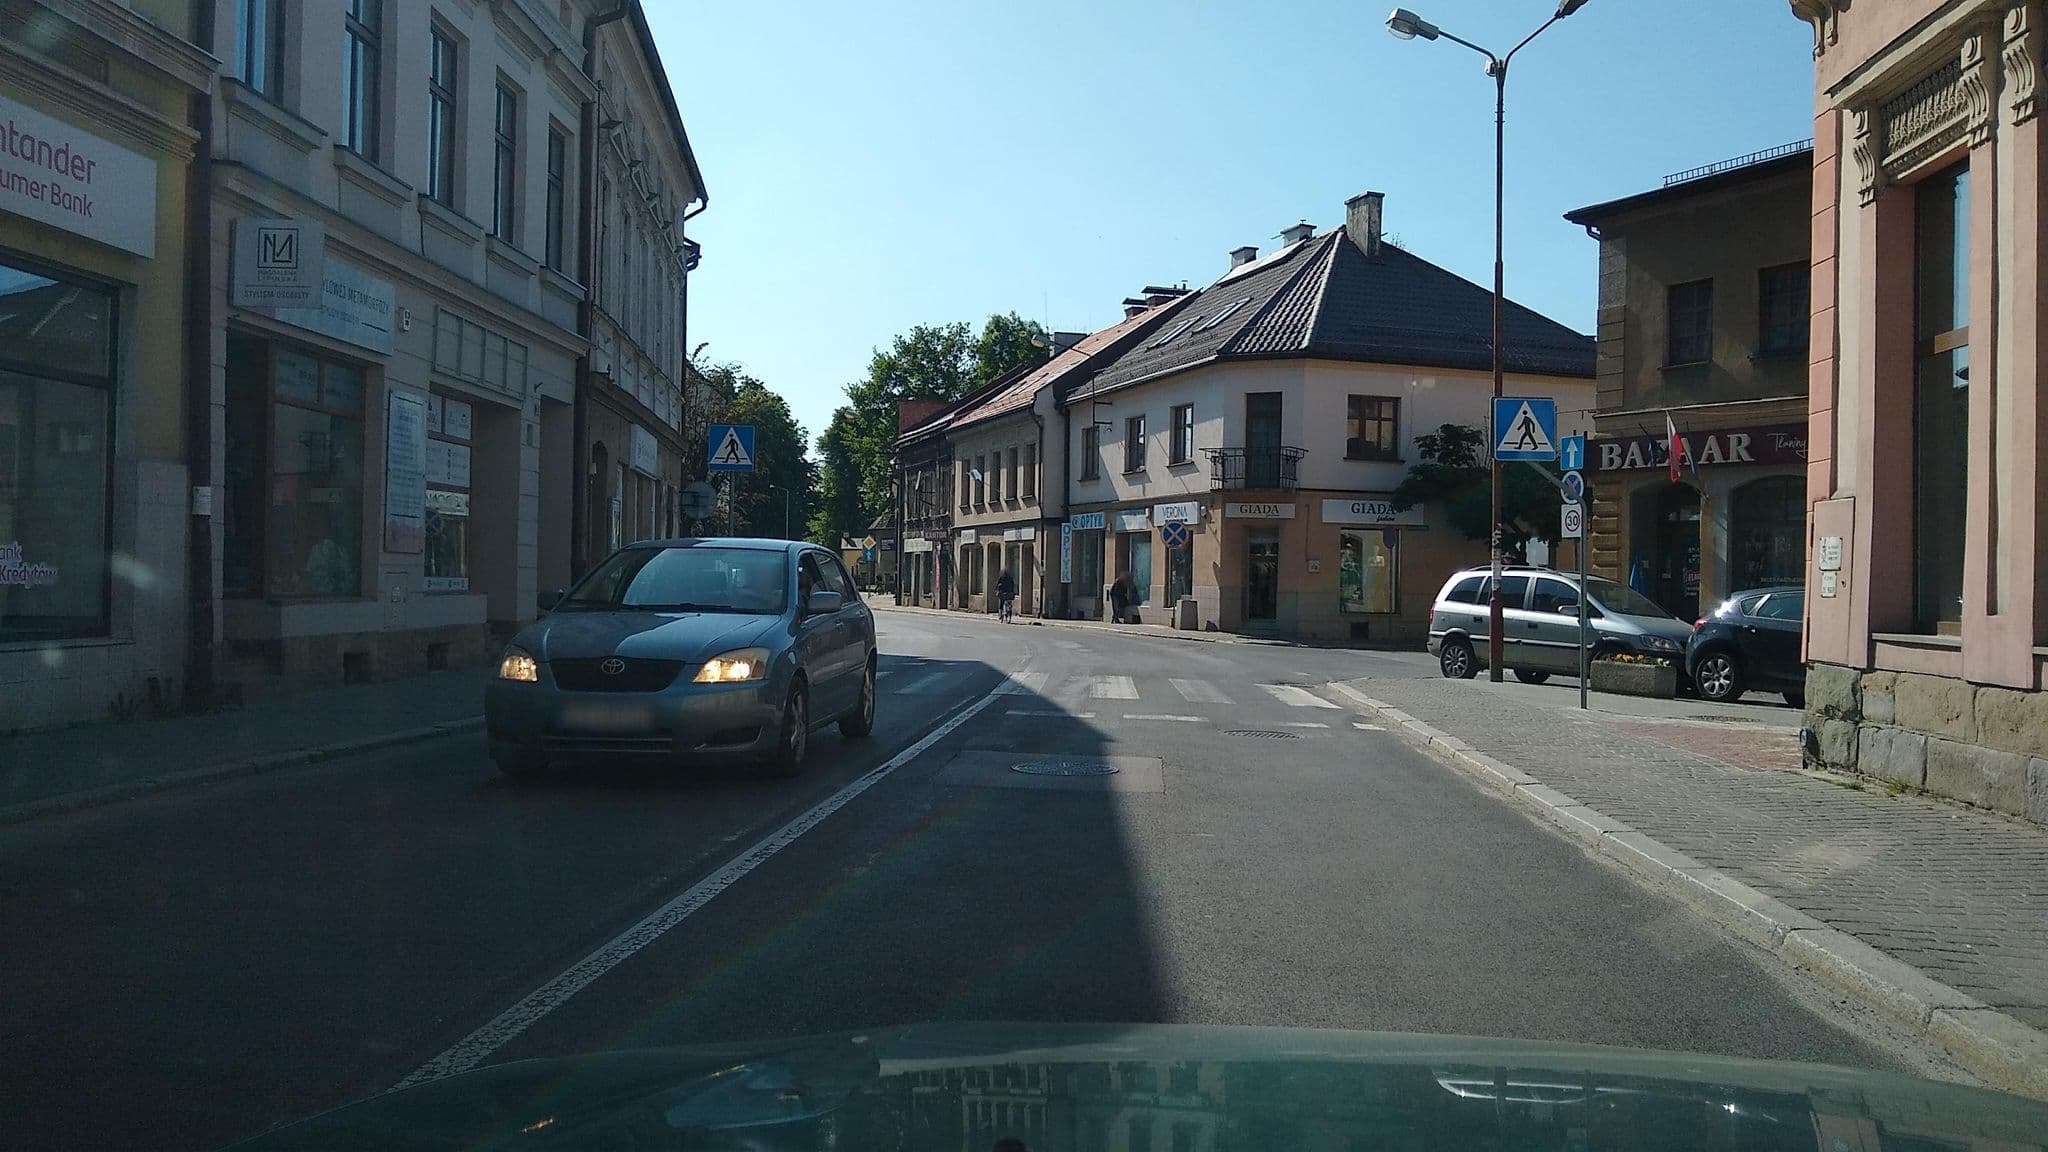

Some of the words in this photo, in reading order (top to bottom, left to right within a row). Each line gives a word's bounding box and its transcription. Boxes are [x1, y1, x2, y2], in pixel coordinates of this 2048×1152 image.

[51, 182, 93, 218] Bank
[1162, 506, 1188, 518] VERONA
[1239, 504, 1280, 514] GIADA
[1350, 503, 1395, 514] GIADA
[1081, 513, 1103, 528] OPTYK
[1567, 515, 1578, 527] 30
[1062, 524, 1071, 581] OPTYK
